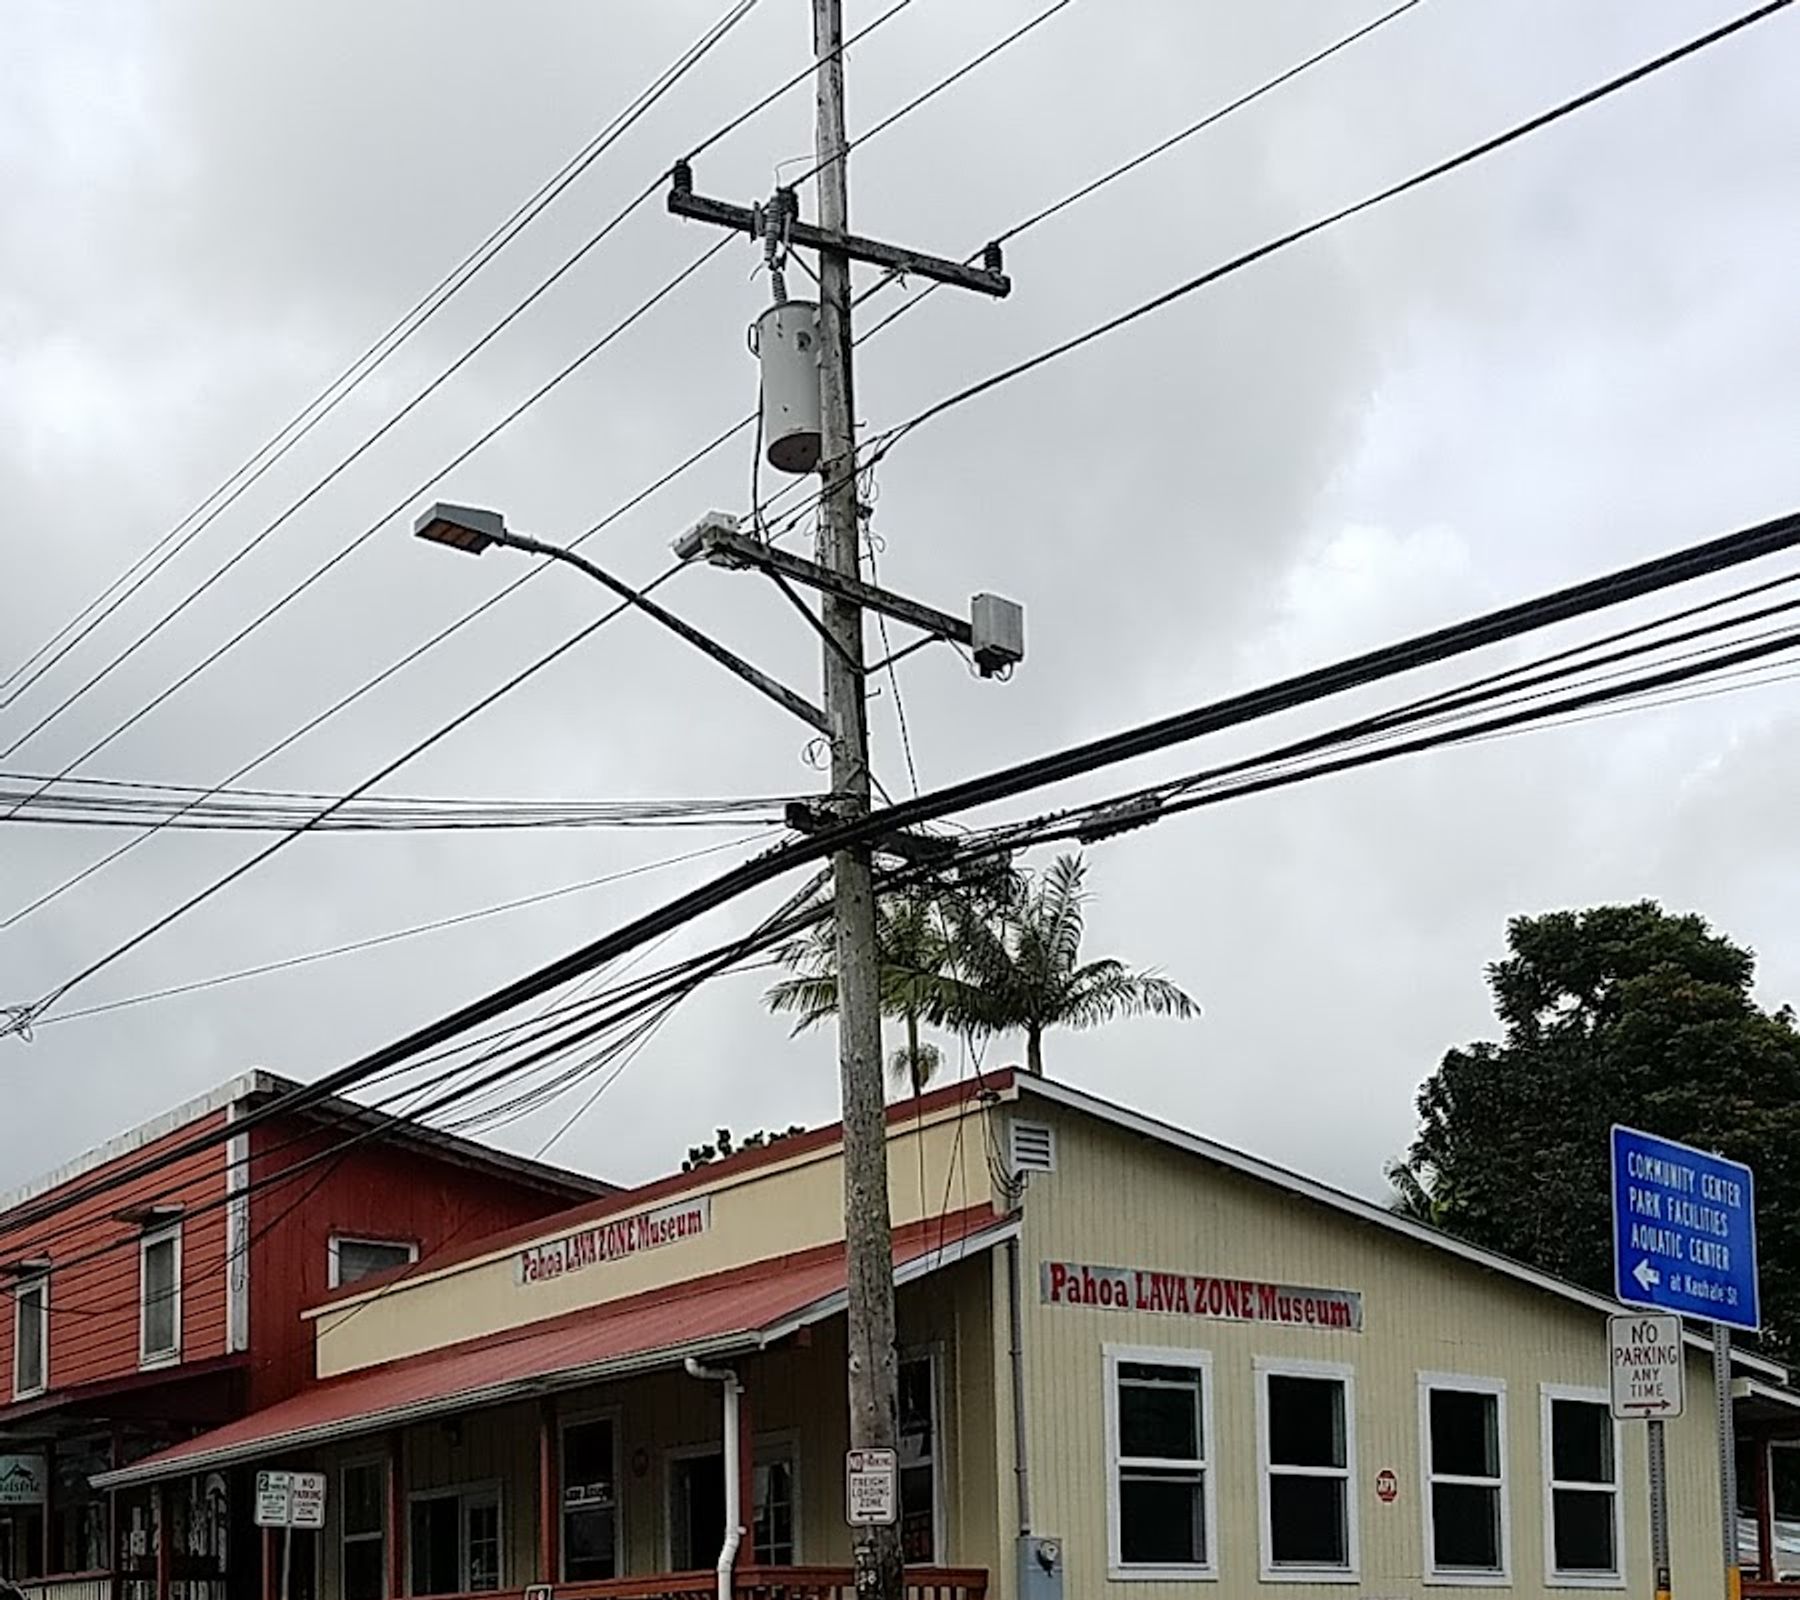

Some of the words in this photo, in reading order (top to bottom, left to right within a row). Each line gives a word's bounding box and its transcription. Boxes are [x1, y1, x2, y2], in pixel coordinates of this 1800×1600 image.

[1628, 1151, 1695, 1194] COMMUNITY
[1702, 1173, 1741, 1209] CENTER
[1629, 1186, 1661, 1220] PARK
[1668, 1196, 1728, 1238] FACILITIES
[523, 1248, 563, 1283] Pahoa
[566, 1230, 596, 1270] LAVA
[599, 1221, 636, 1262] ZONE
[638, 1210, 703, 1250] Museum
[1631, 1222, 1683, 1260] AQUATIC
[1689, 1237, 1730, 1271] CENTER
[1670, 1273, 1682, 1291] at
[1050, 1262, 1129, 1308] Pahoa
[1135, 1270, 1190, 1314] LAVA
[1193, 1277, 1254, 1319] ZONE
[1258, 1283, 1351, 1328] Museum
[1632, 1324, 1658, 1344] NO
[1614, 1345, 1678, 1367] PARKING
[1632, 1368, 1660, 1381] ANY
[1630, 1383, 1664, 1398] TIME
[302, 1478, 316, 1489] NO
